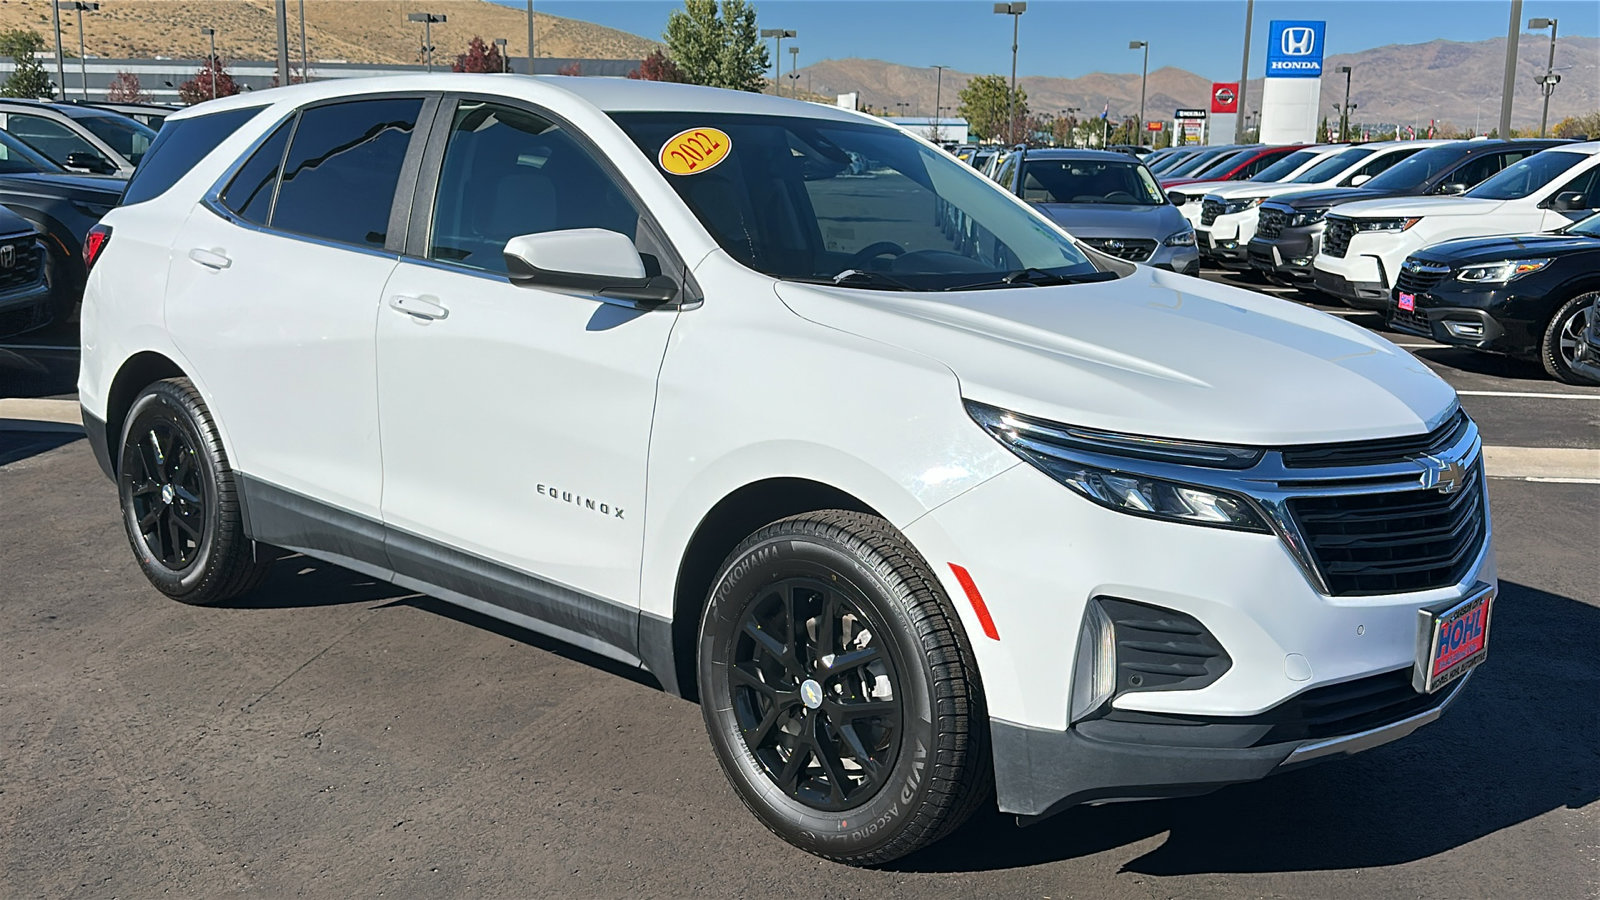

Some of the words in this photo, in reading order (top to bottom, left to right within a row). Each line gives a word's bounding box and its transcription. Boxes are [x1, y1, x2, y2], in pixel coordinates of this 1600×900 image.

[1271, 61, 1320, 70] HONDA
[671, 132, 720, 170] 2022
[537, 483, 625, 520] EQUINOX
[716, 545, 779, 602] YOKOHAMA
[1436, 609, 1481, 659] HOHL
[901, 737, 927, 805] AVID
